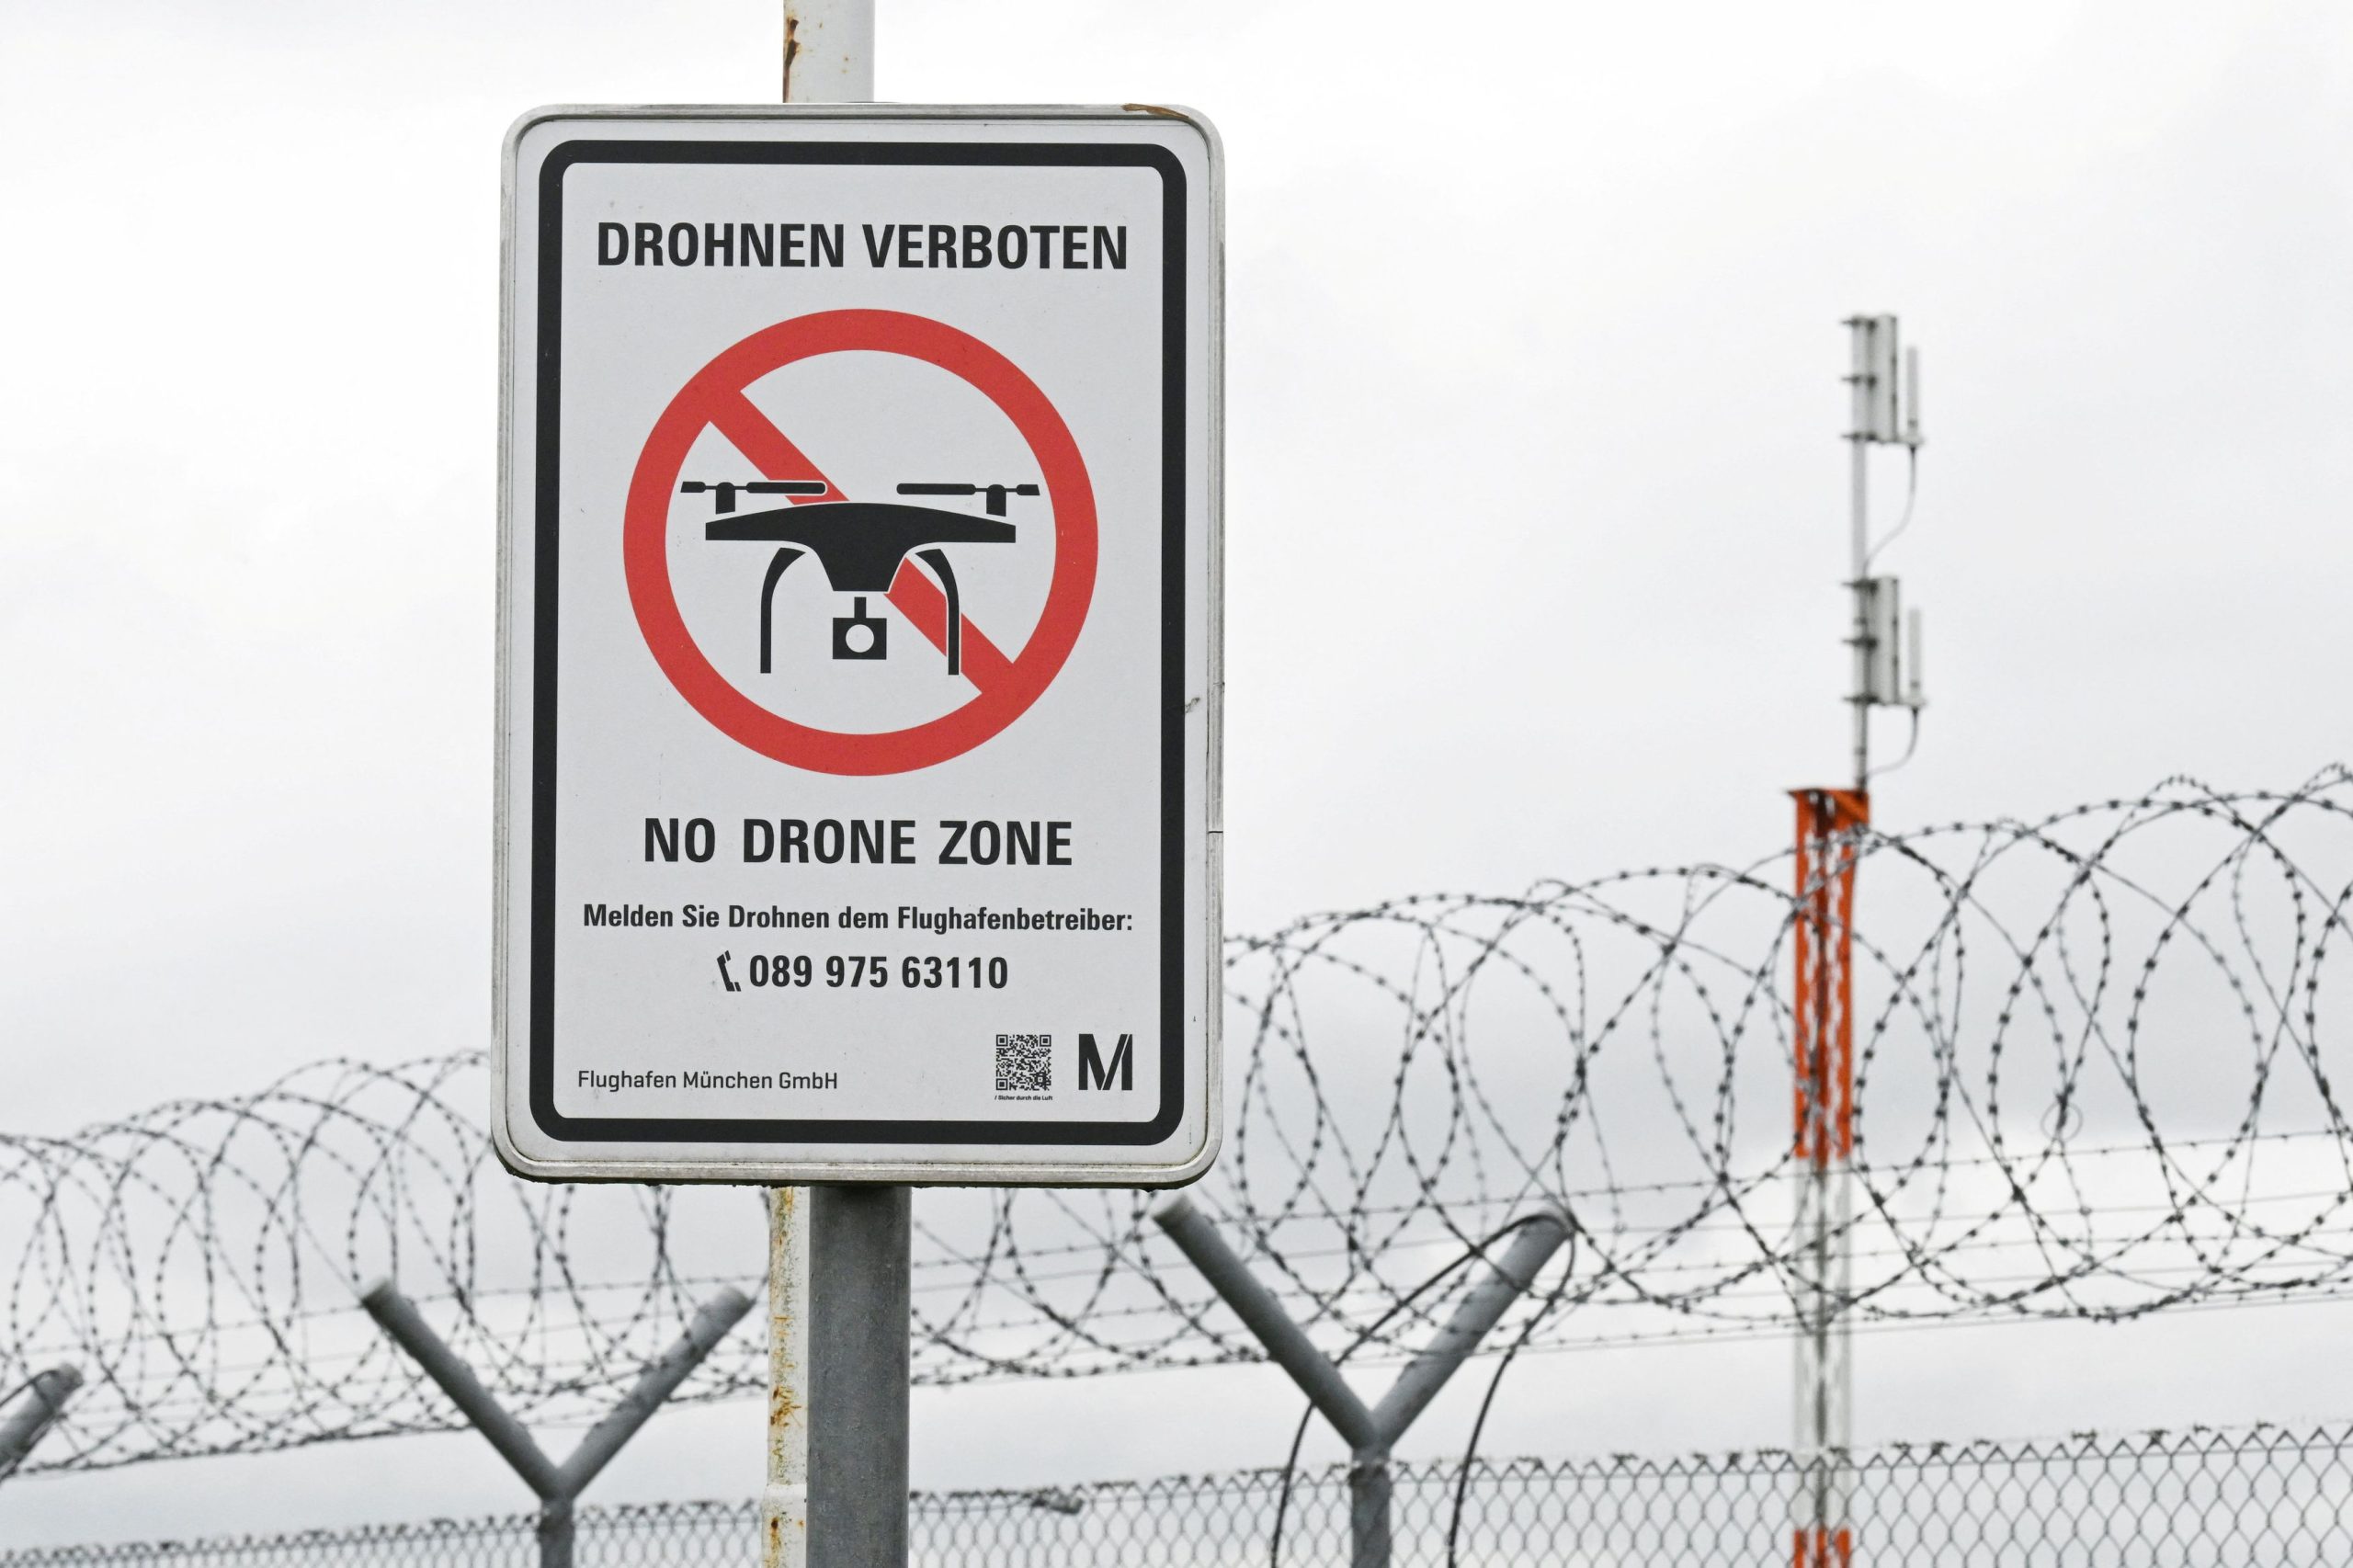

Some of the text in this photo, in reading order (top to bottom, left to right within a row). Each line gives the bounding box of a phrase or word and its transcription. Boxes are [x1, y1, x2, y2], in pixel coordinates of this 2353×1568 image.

[598, 222, 1127, 270] DROHNEN VERBOTEN
[645, 817, 1073, 866] NO DRONE ZONE
[584, 903, 1133, 936] Melden Sie Drohnen dem Flughafenbetreiber:
[750, 954, 1008, 990] 089 975 63110
[578, 1070, 838, 1092] Flughafen München GmbH
[1078, 1033, 1133, 1091] M
